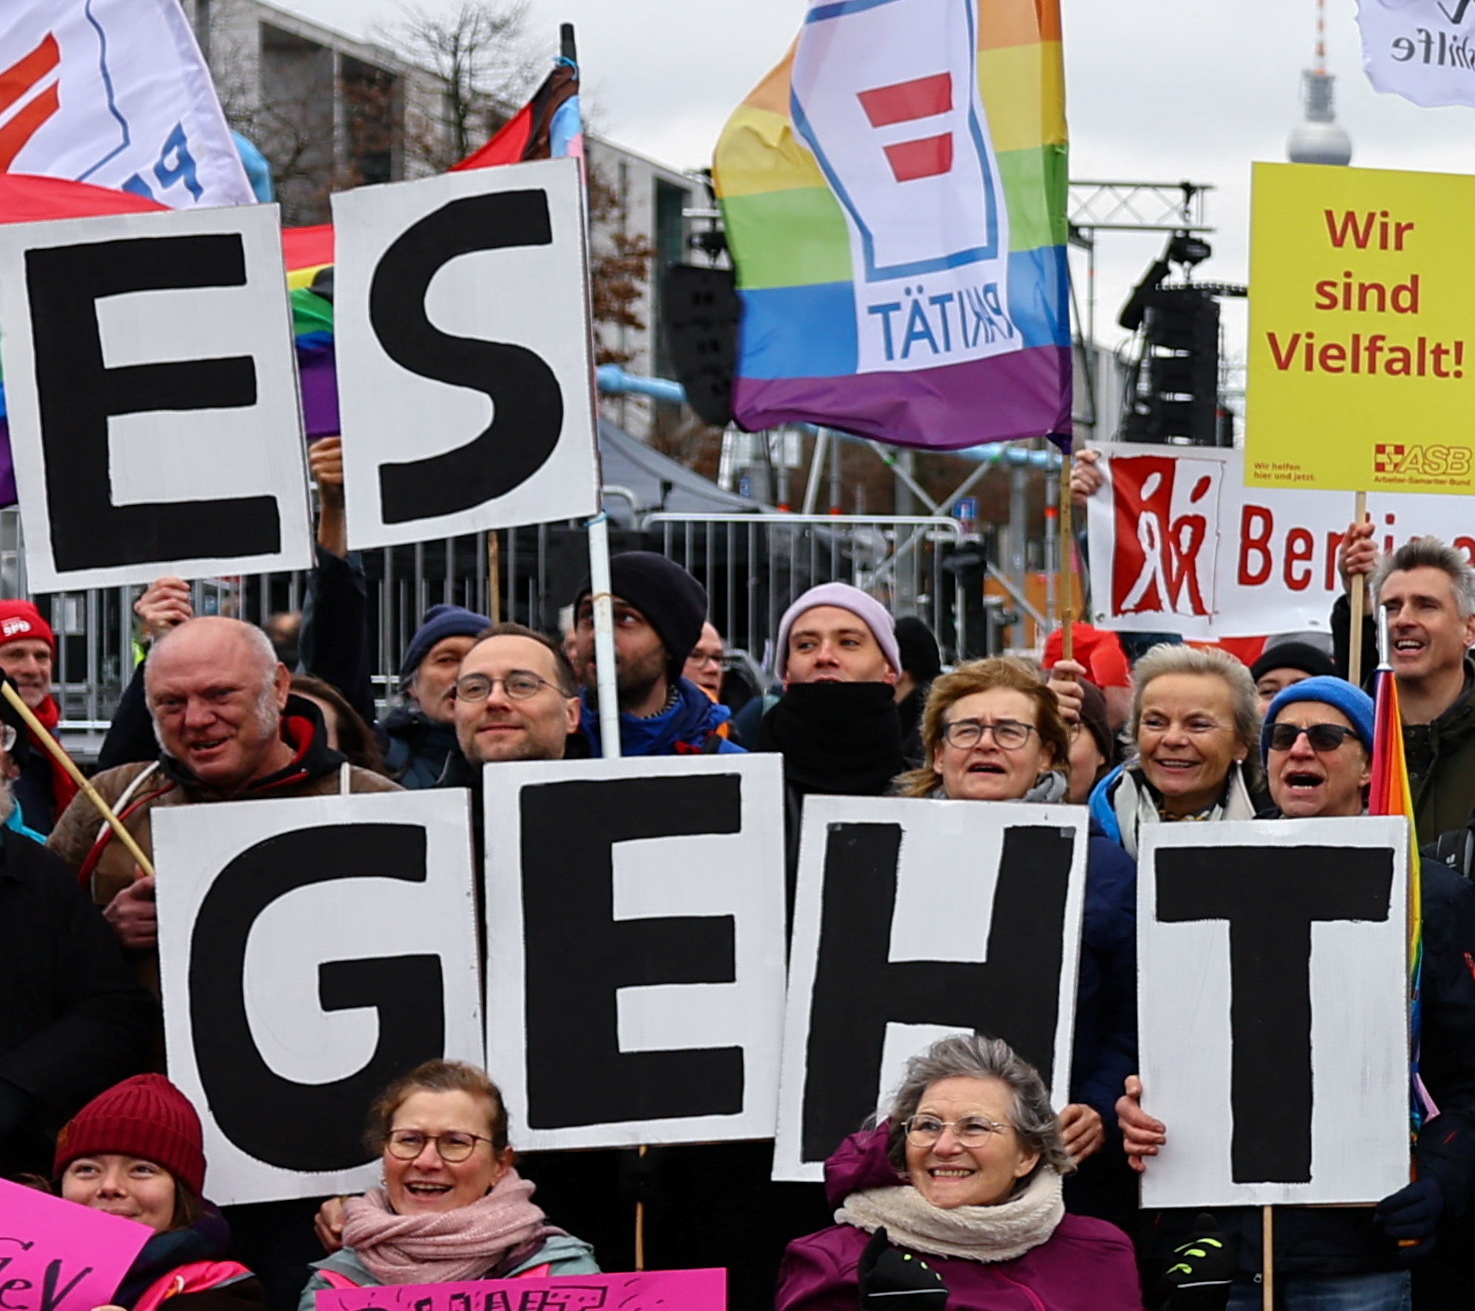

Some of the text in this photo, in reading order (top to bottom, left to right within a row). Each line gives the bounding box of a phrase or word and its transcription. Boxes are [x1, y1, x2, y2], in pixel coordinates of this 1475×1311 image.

[1324, 209, 1414, 251] Wir
[1314, 270, 1419, 314] sind
[1266, 331, 1464, 379] Vielfalt!
[1254, 471, 1291, 481] hier und
[1272, 462, 1300, 471] helfen
[1400, 445, 1472, 476] ASB
[188, 774, 1396, 1184] GEHT
